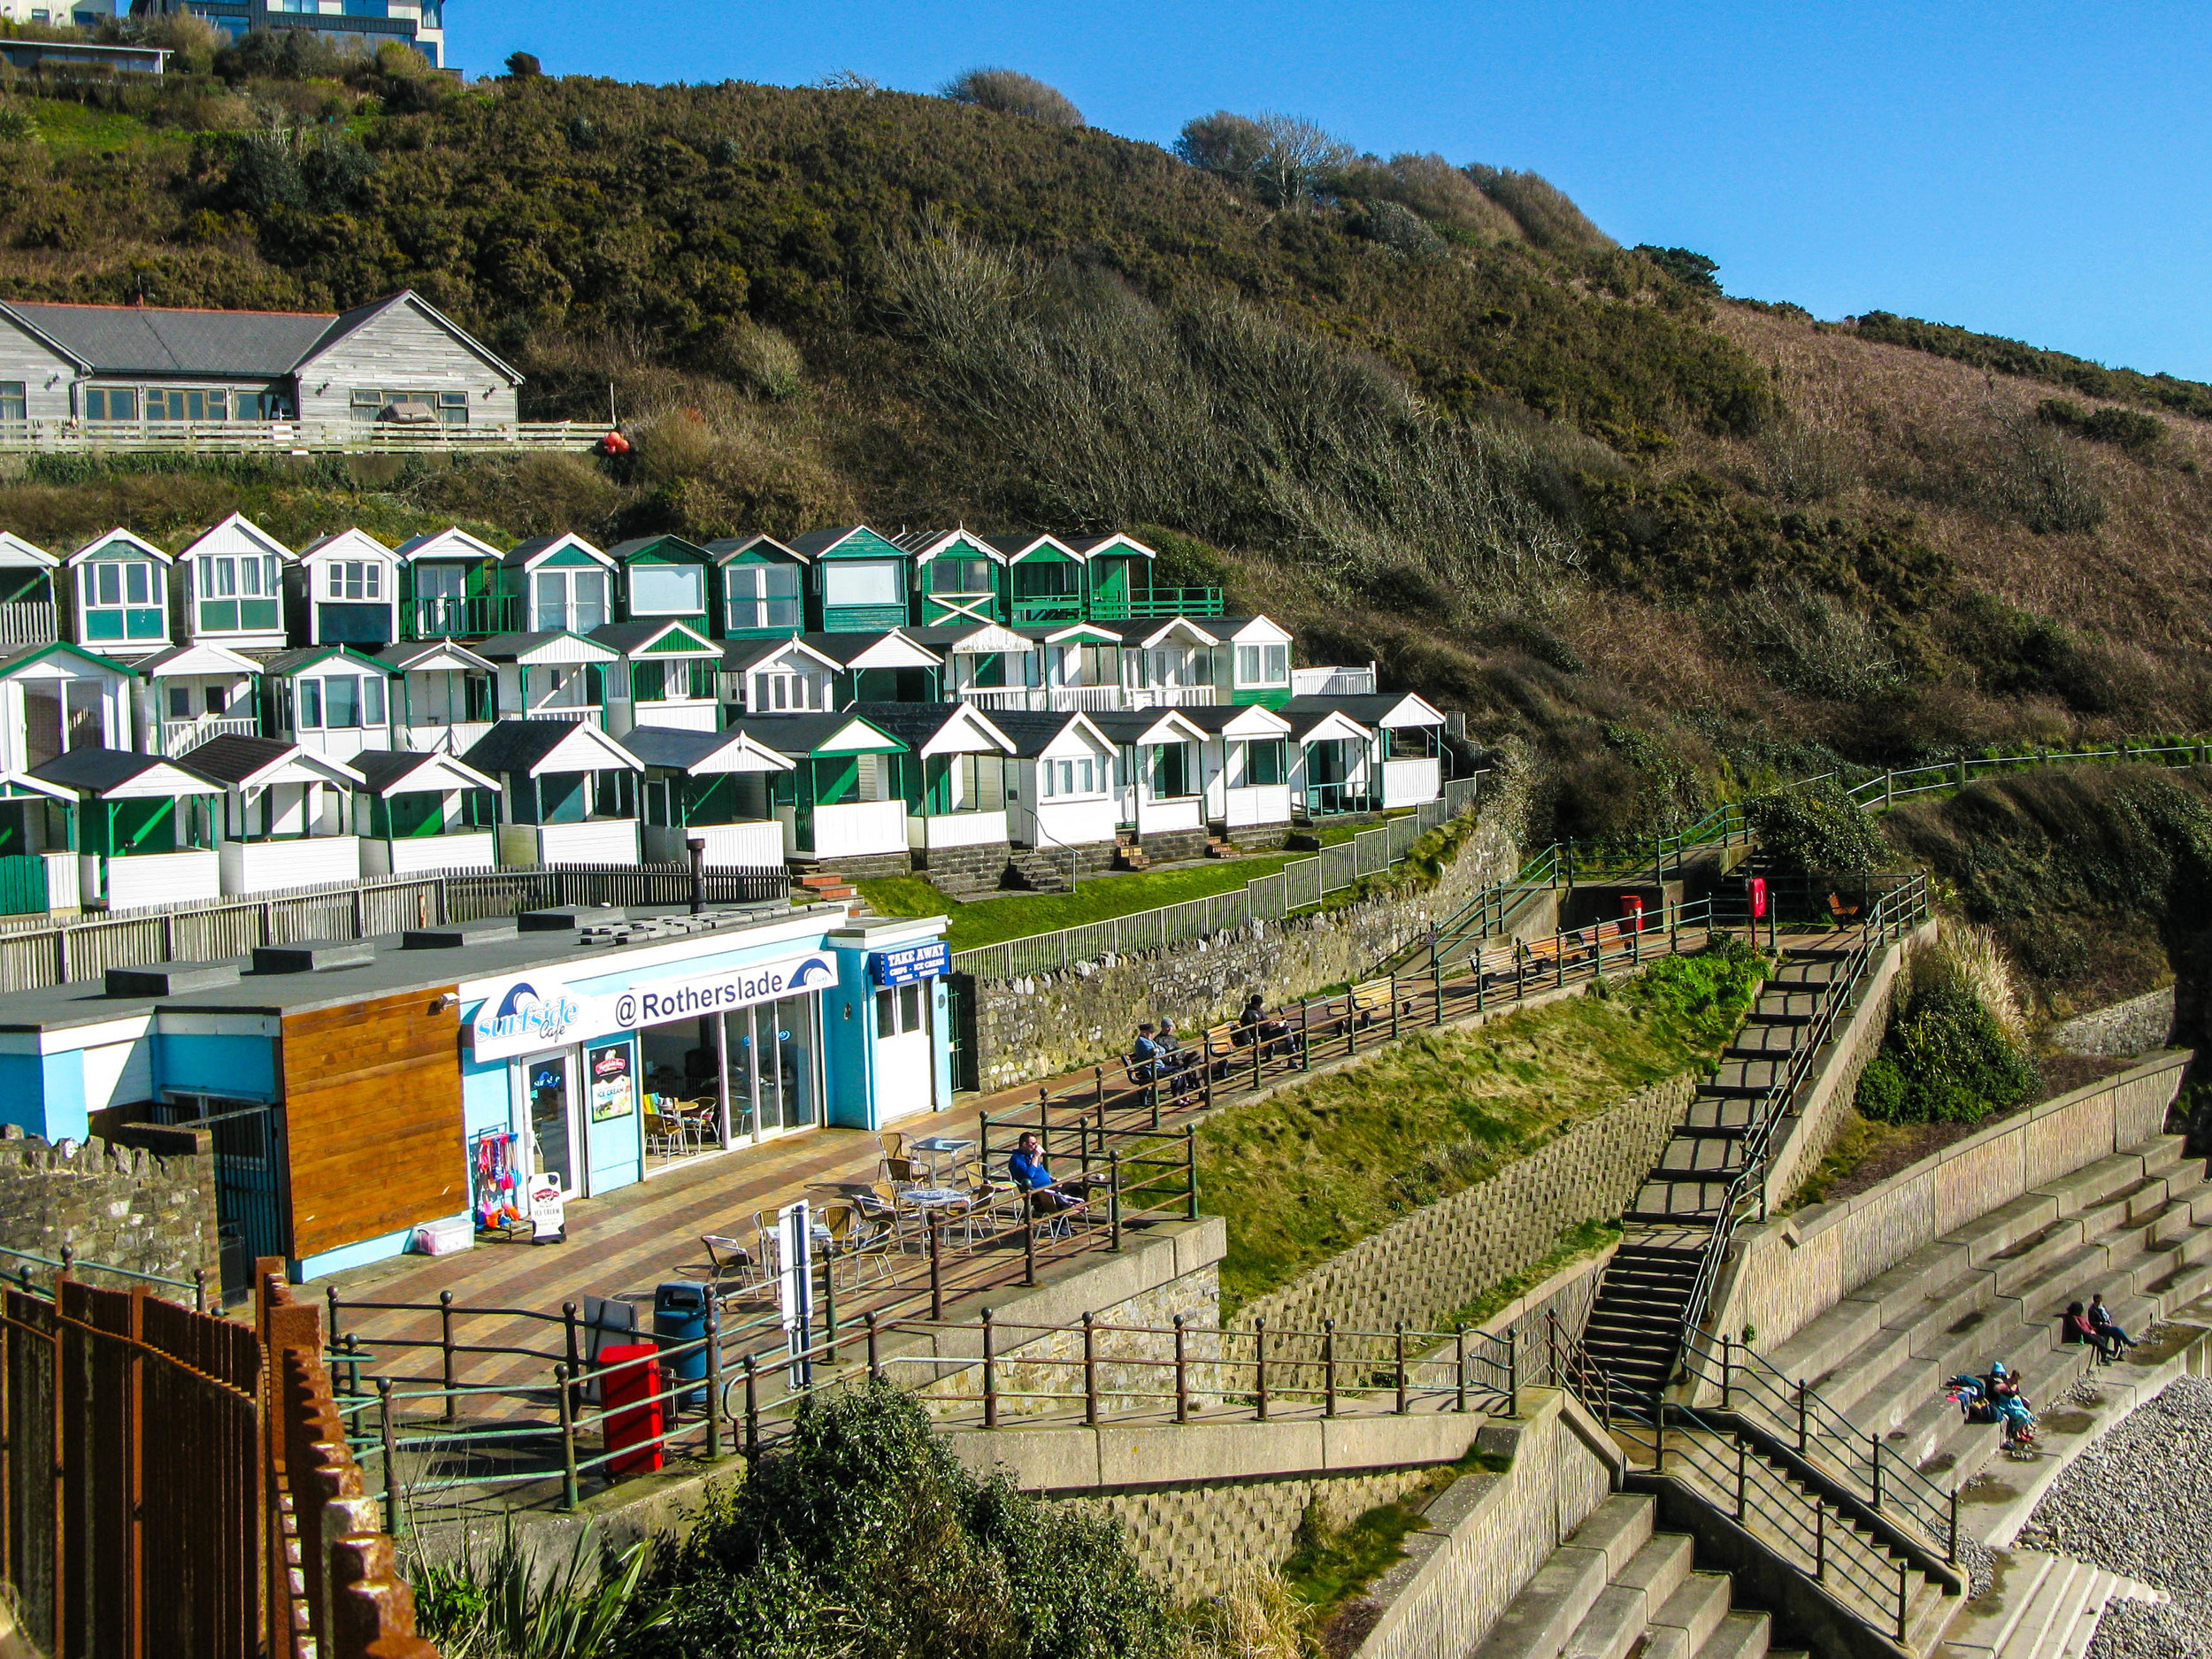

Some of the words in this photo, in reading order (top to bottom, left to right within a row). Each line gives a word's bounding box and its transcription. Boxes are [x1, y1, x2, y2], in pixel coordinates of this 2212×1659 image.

[888, 950, 915, 967] TAKE
[917, 944, 945, 961] AWAY
[889, 965, 908, 976] CHIPS
[925, 957, 945, 968] CREAM
[643, 971, 782, 1019] Rotherslade
[477, 997, 578, 1042] surfside
[539, 1020, 565, 1043] Cafe
[607, 1087, 624, 1096] CREAM
[543, 1208, 560, 1217] CREAM
